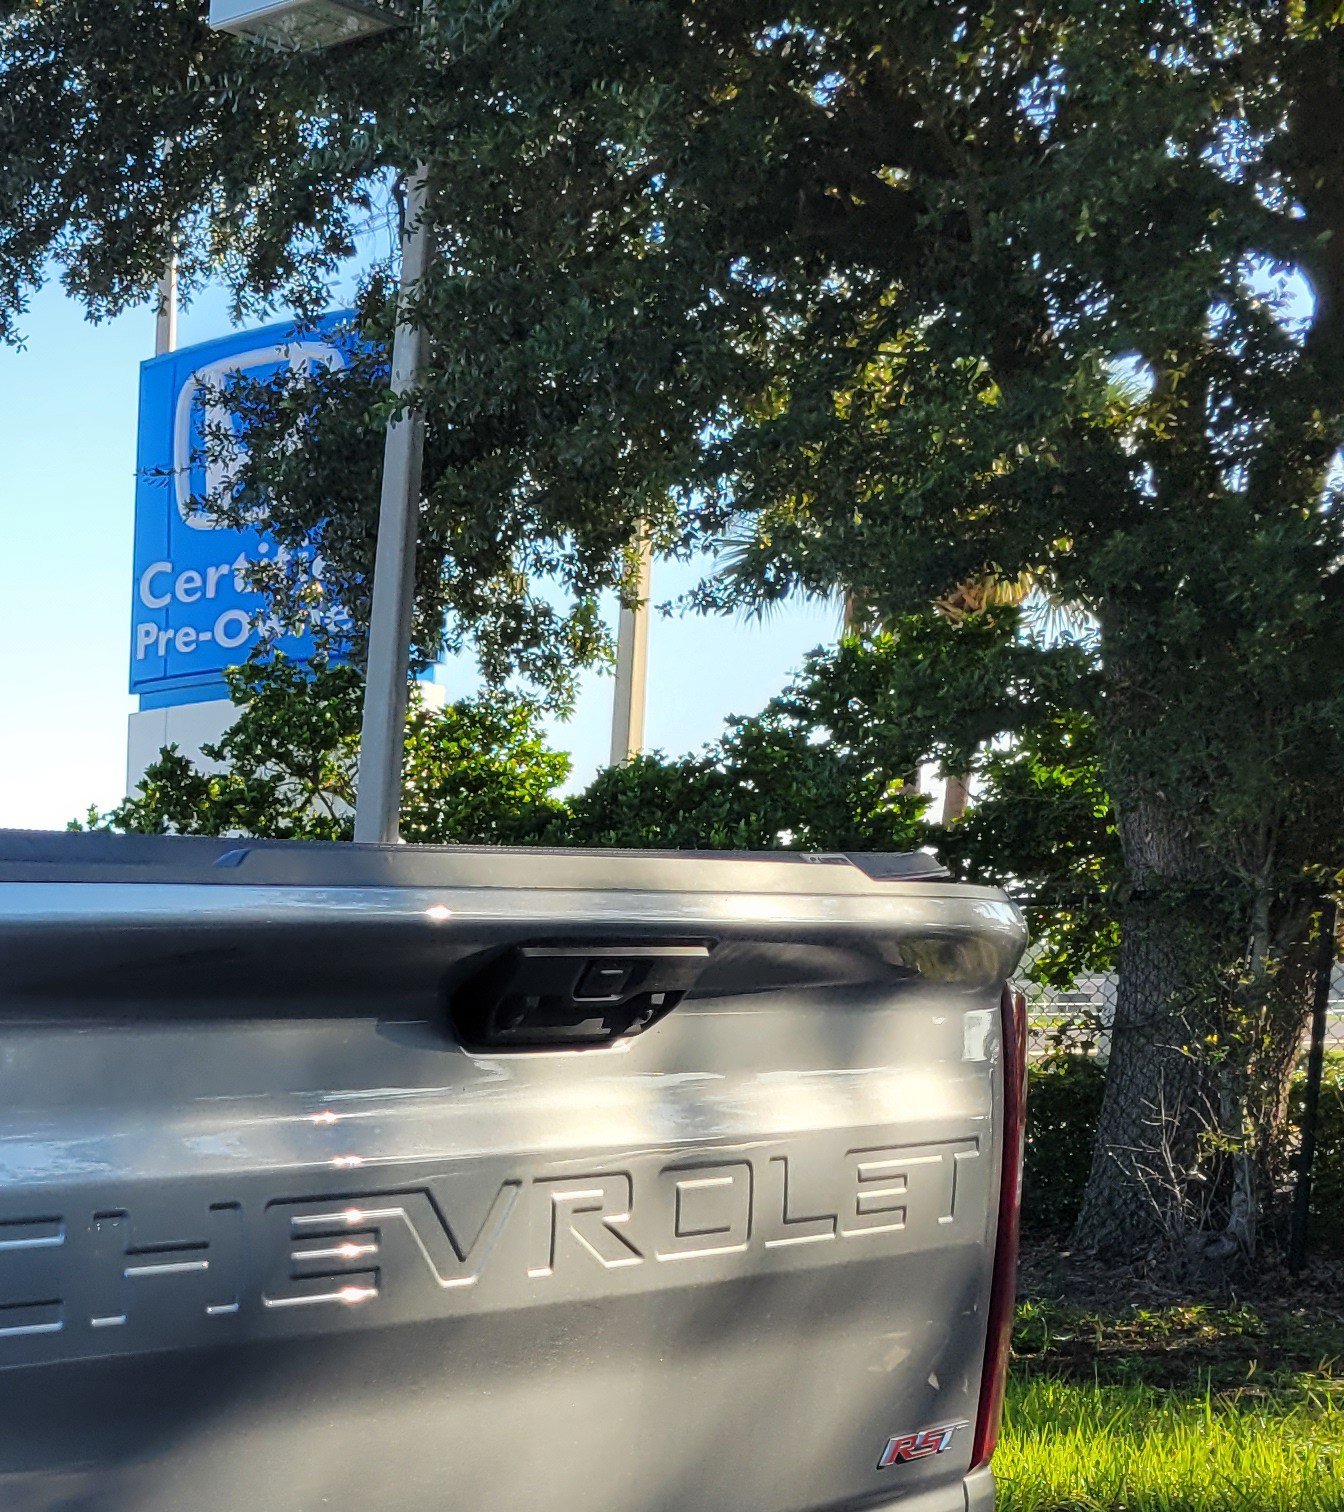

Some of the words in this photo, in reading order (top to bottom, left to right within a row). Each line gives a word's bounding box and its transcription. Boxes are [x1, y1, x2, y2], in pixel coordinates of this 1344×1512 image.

[139, 537, 327, 609] Certifi
[136, 604, 354, 661] Pre-Owe
[876, 1420, 970, 1469] RST
